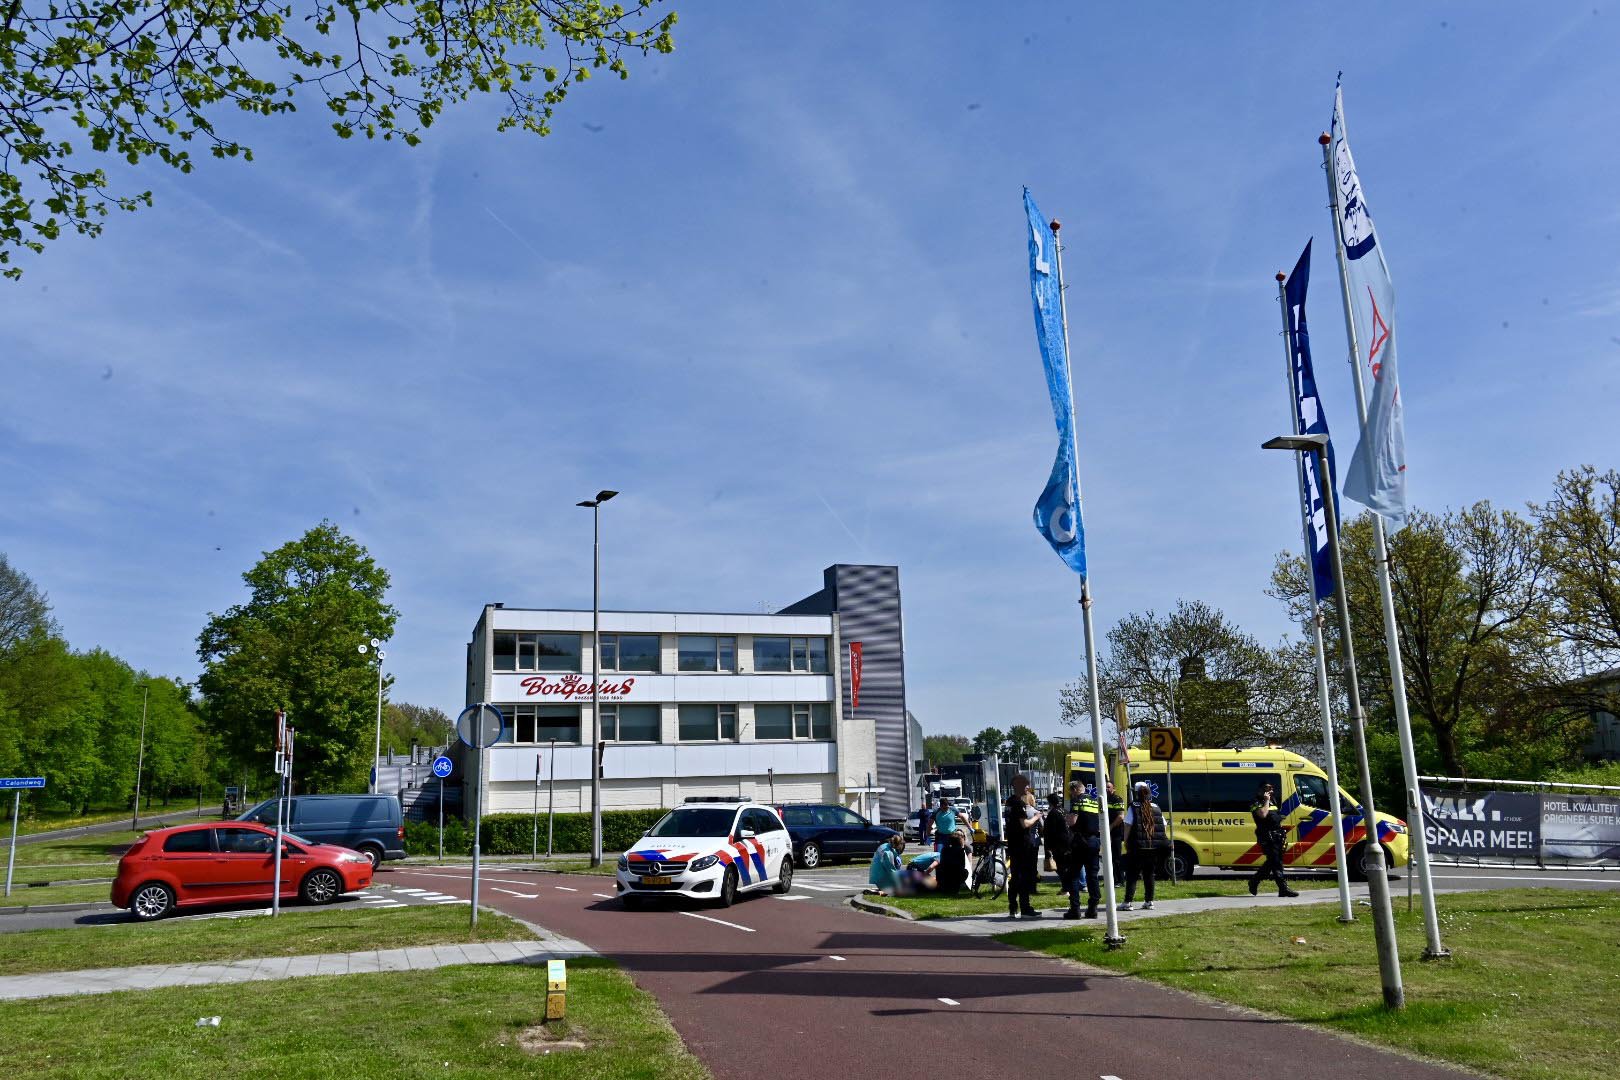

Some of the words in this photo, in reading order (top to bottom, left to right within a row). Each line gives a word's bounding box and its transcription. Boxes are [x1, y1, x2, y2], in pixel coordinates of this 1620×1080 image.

[520, 676, 635, 700] Borgesius
[1155, 733, 1166, 756] 2
[1543, 801, 1572, 812] HOTEL
[1572, 802, 1618, 814] KWALITEIT
[1180, 818, 1245, 826] AMBULANCE
[1543, 813, 1589, 825] ORIGINEEL
[1589, 815, 1614, 825] SUITE
[1425, 826, 1486, 849] SPAAR
[1490, 830, 1533, 849] MEE!
